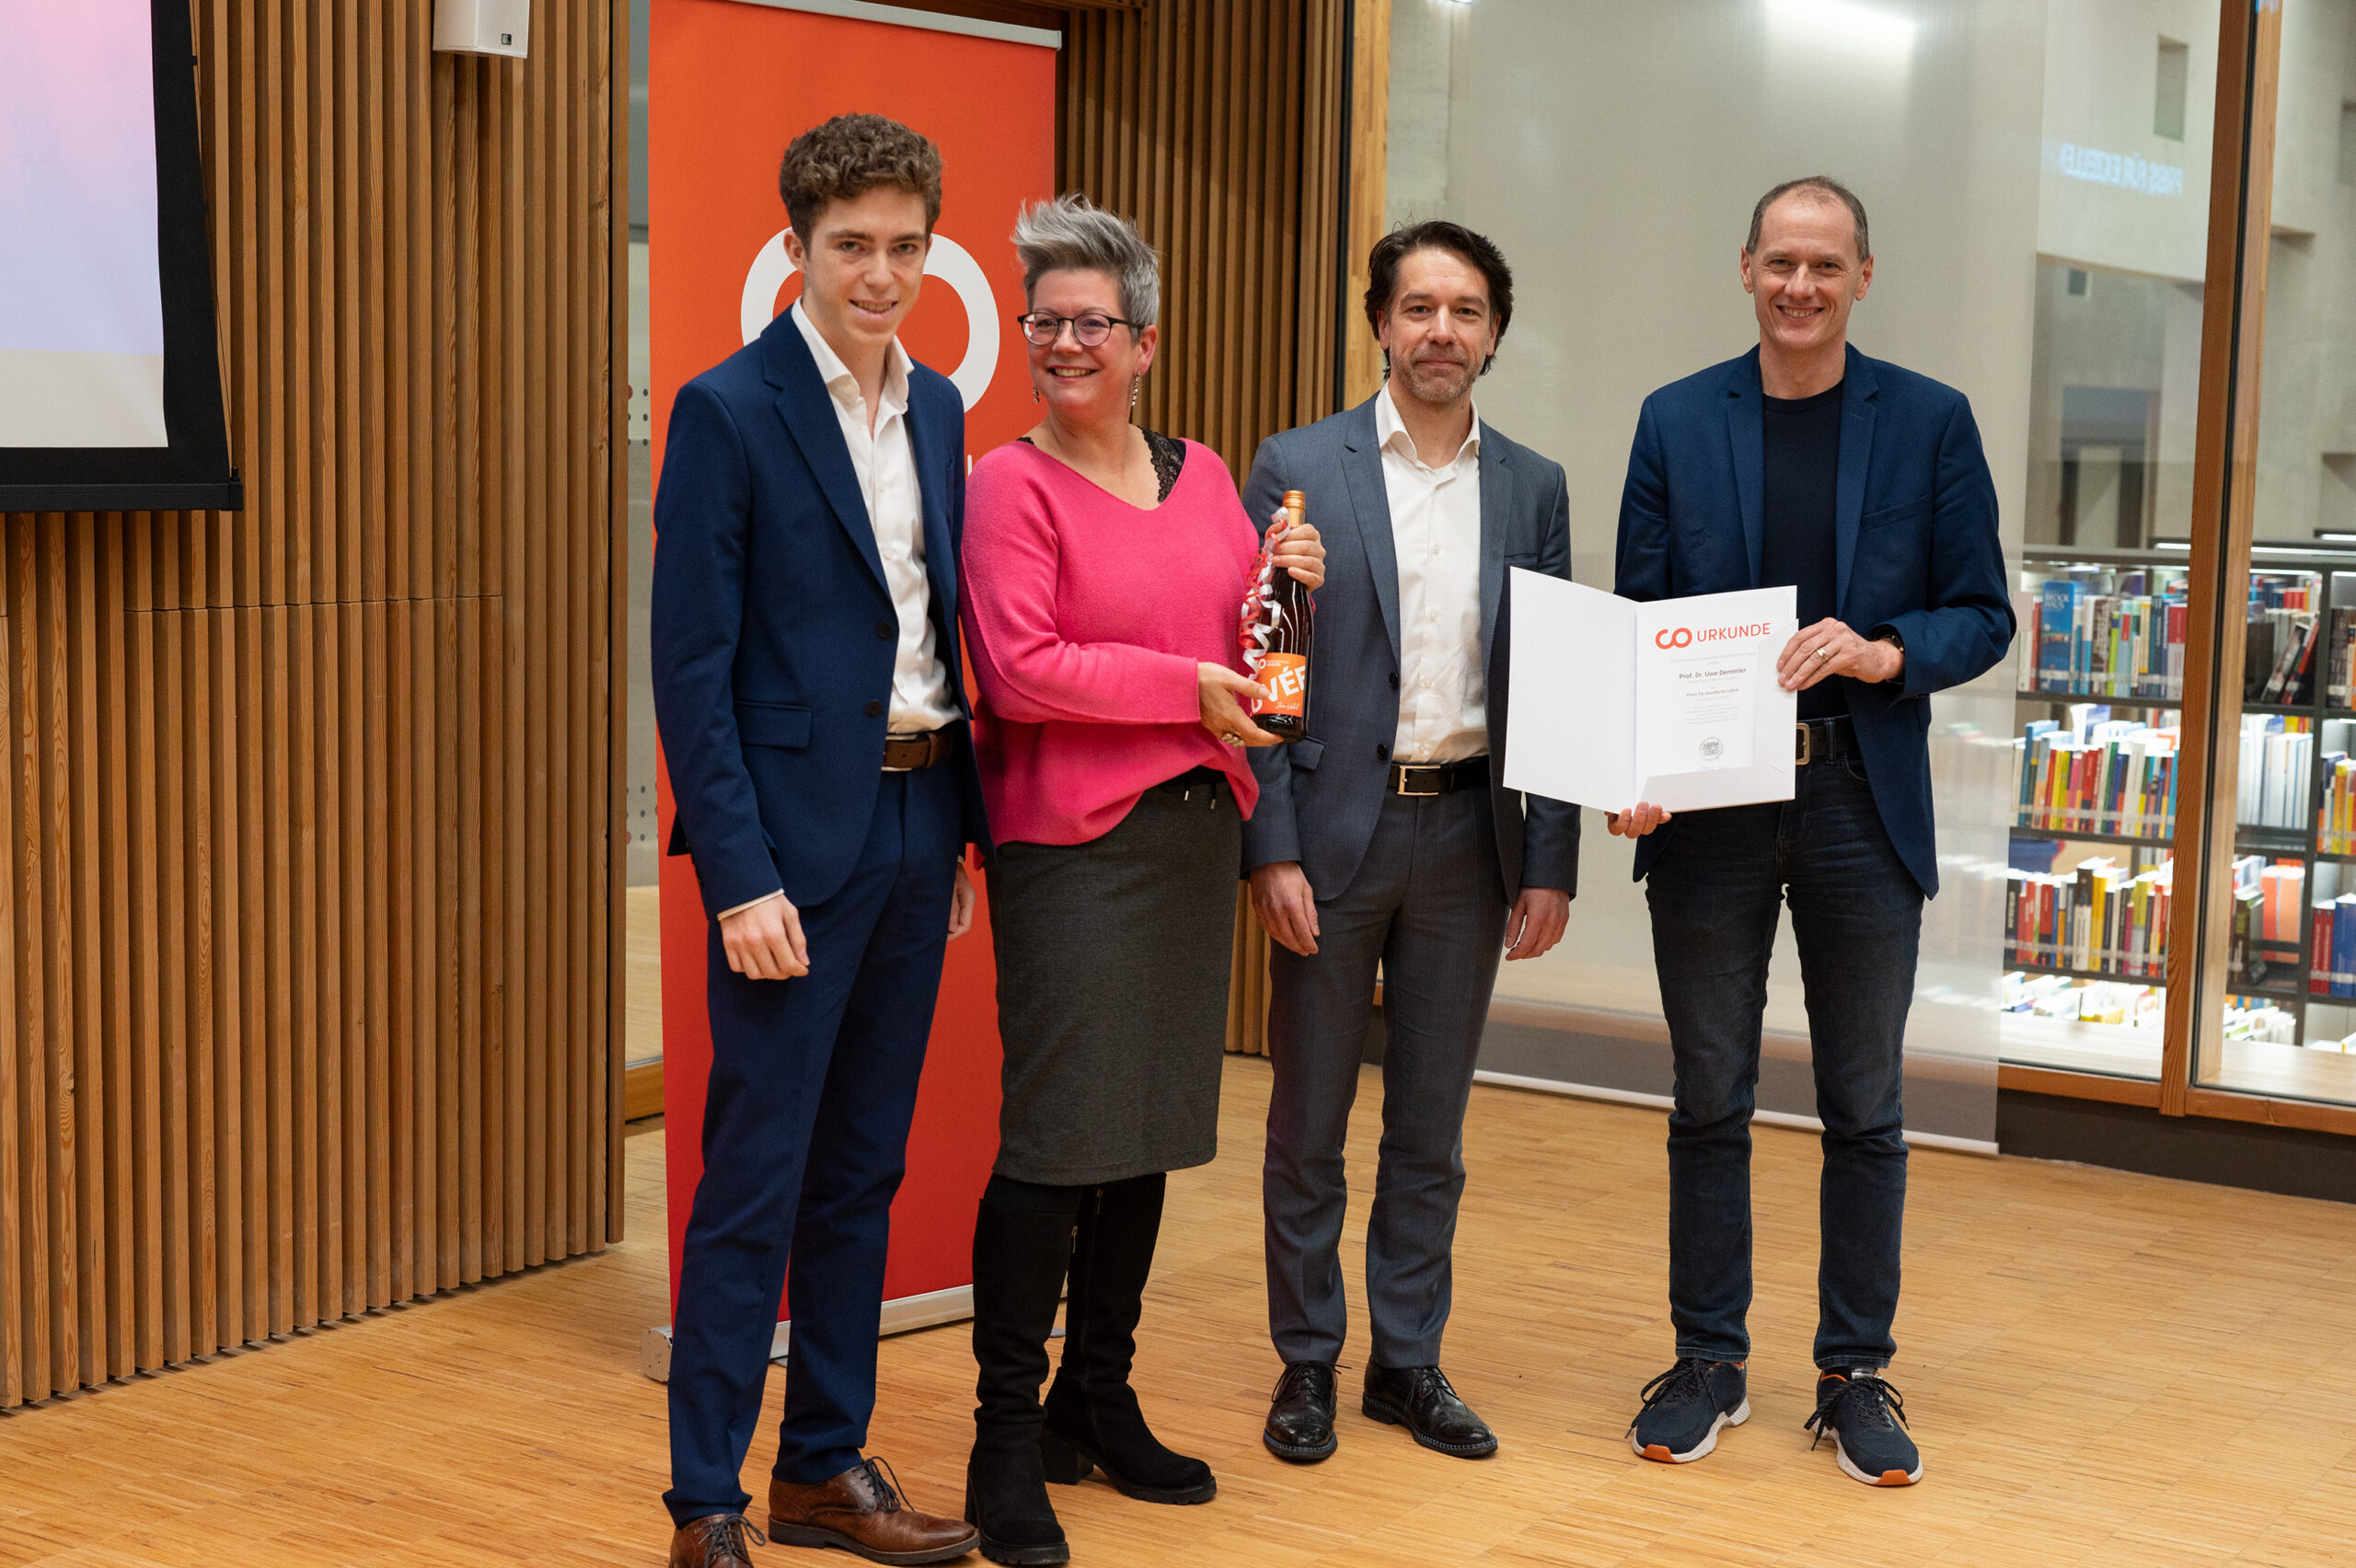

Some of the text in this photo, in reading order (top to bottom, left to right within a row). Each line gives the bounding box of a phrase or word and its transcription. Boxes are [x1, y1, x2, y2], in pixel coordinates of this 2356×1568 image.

[1697, 623, 1771, 642] URKUNDE
[1679, 672, 1693, 680] Prof.
[1719, 667, 1747, 676] Demmler
